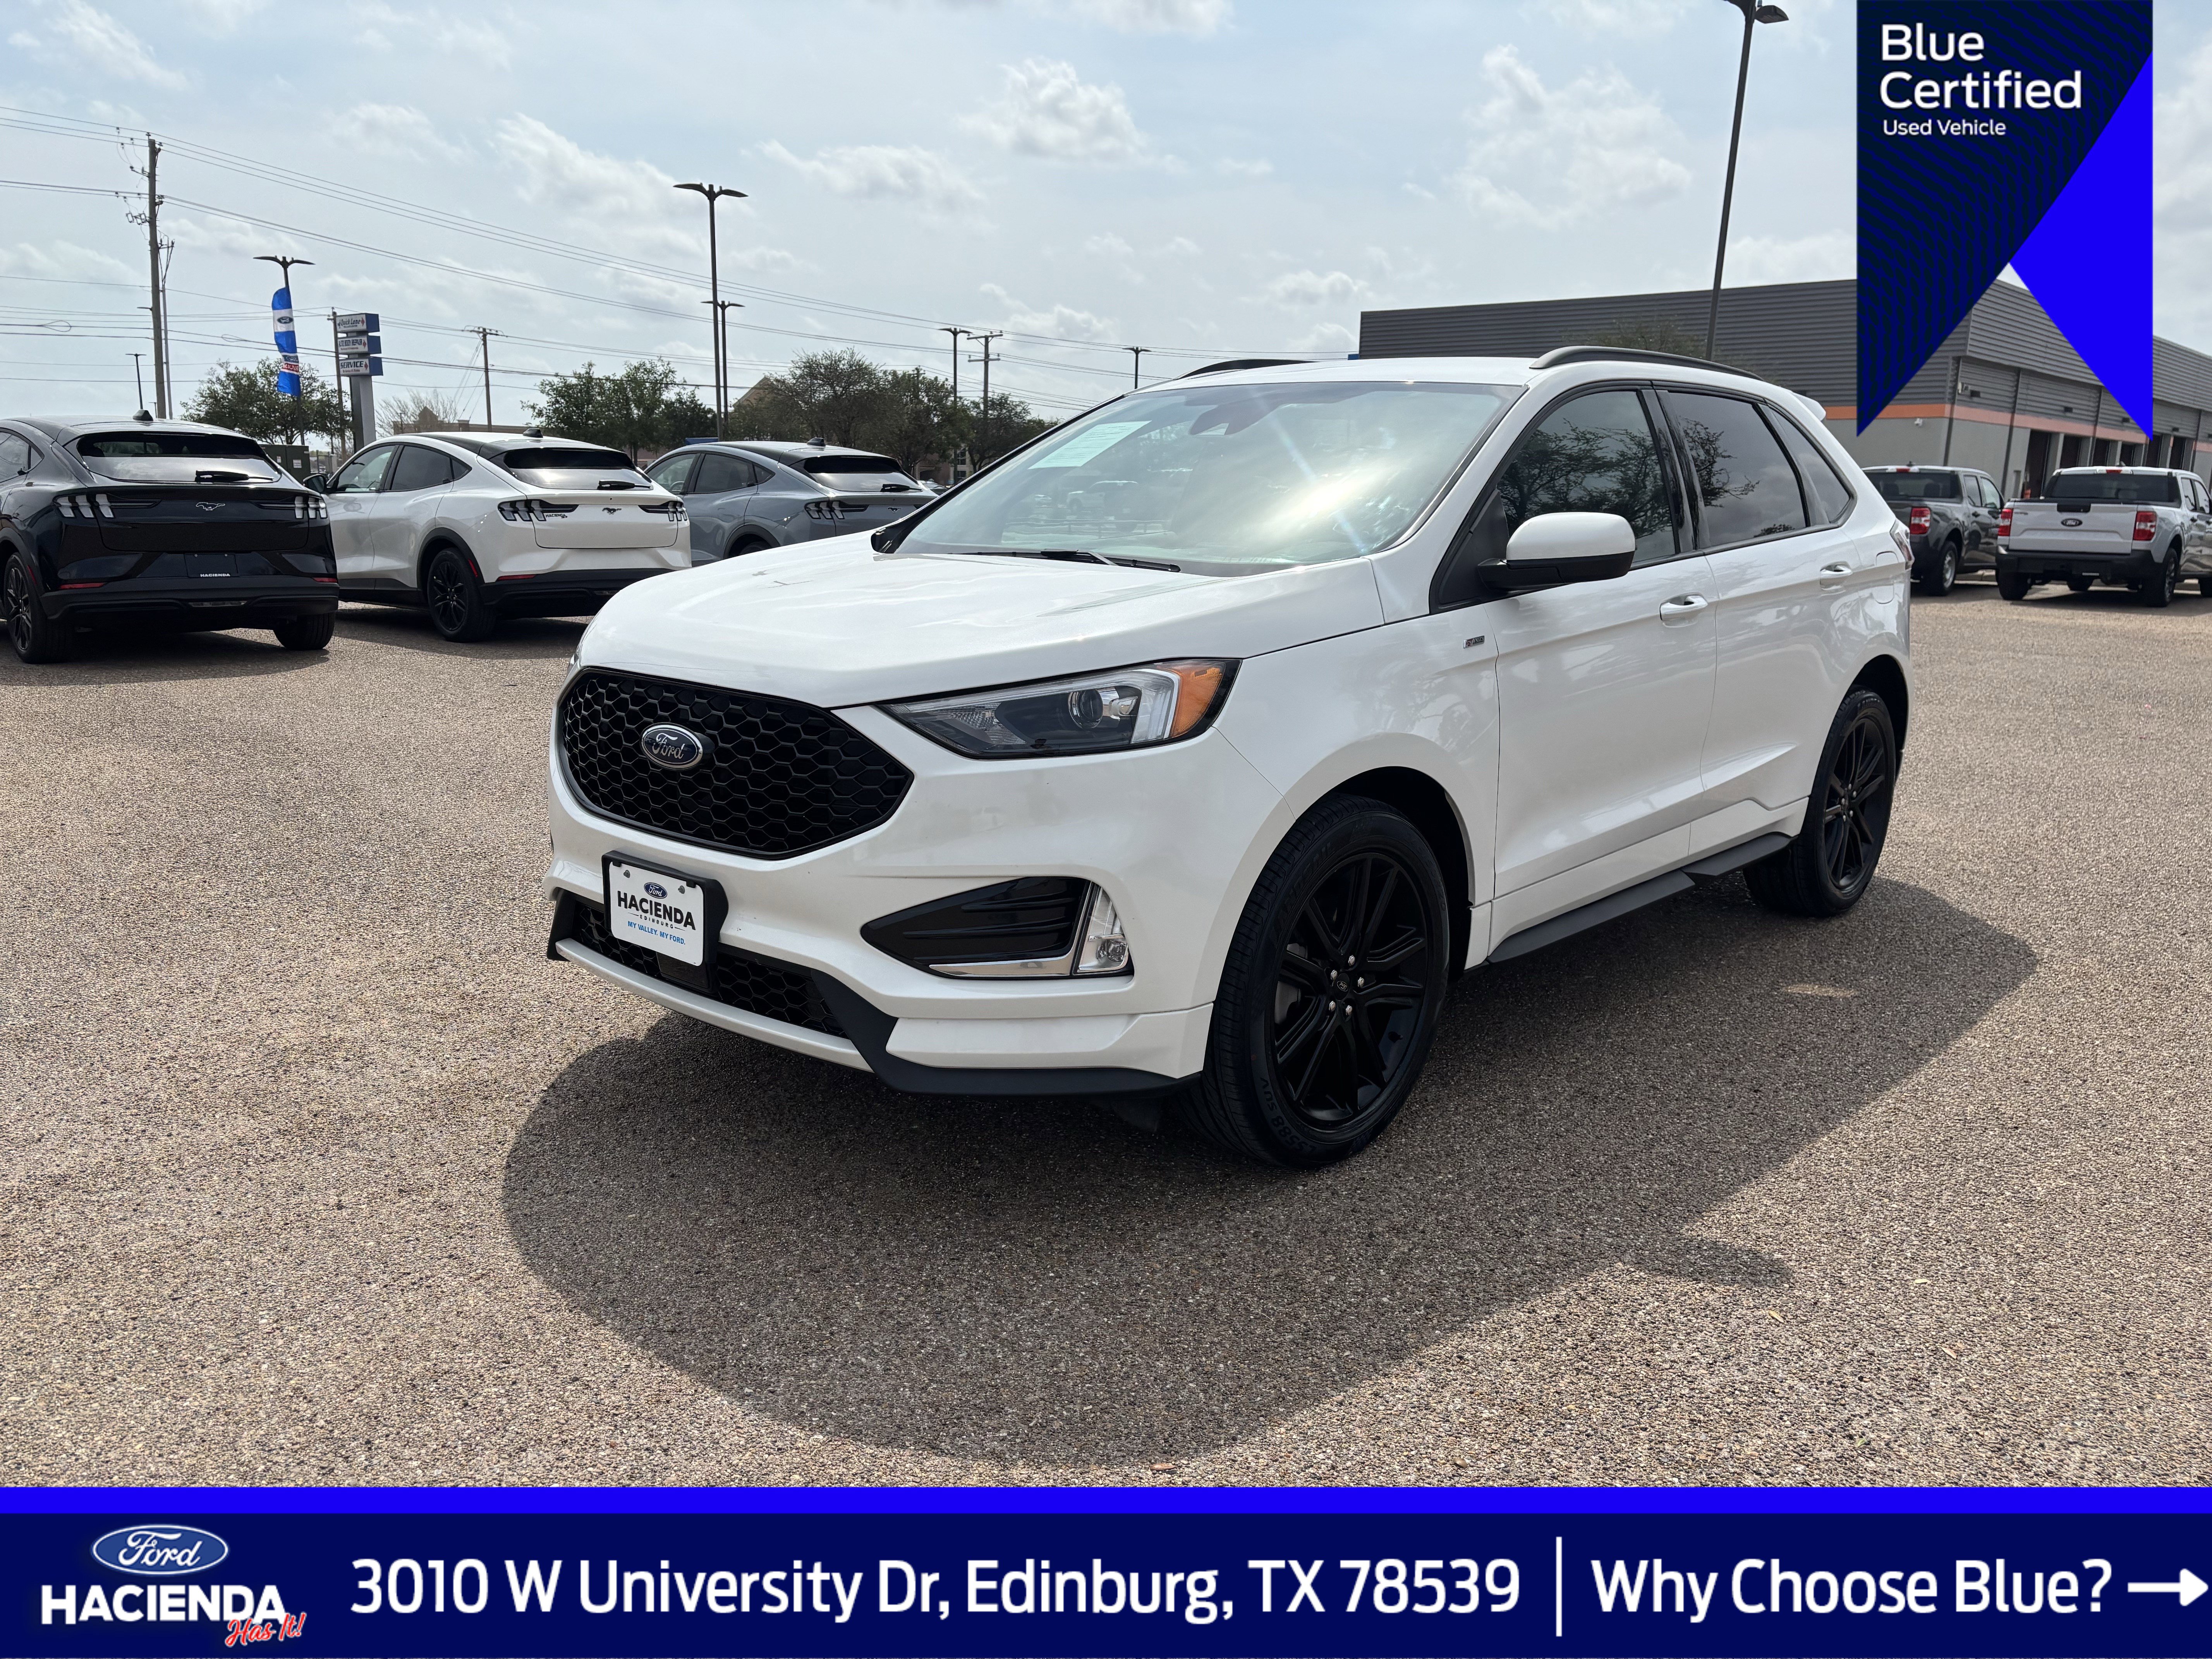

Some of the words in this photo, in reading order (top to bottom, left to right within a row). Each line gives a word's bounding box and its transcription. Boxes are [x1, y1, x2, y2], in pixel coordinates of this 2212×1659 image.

[340, 361, 364, 369] SERVICE
[652, 733, 685, 759] Ford
[648, 884, 663, 897] Ford
[617, 891, 696, 930] HACIENDA
[640, 914, 673, 929] EDINBURG
[638, 924, 658, 936] VALLEY.
[659, 931, 668, 939] MY
[670, 934, 685, 945] FORD.
[1260, 1077, 1277, 1111] SUV
